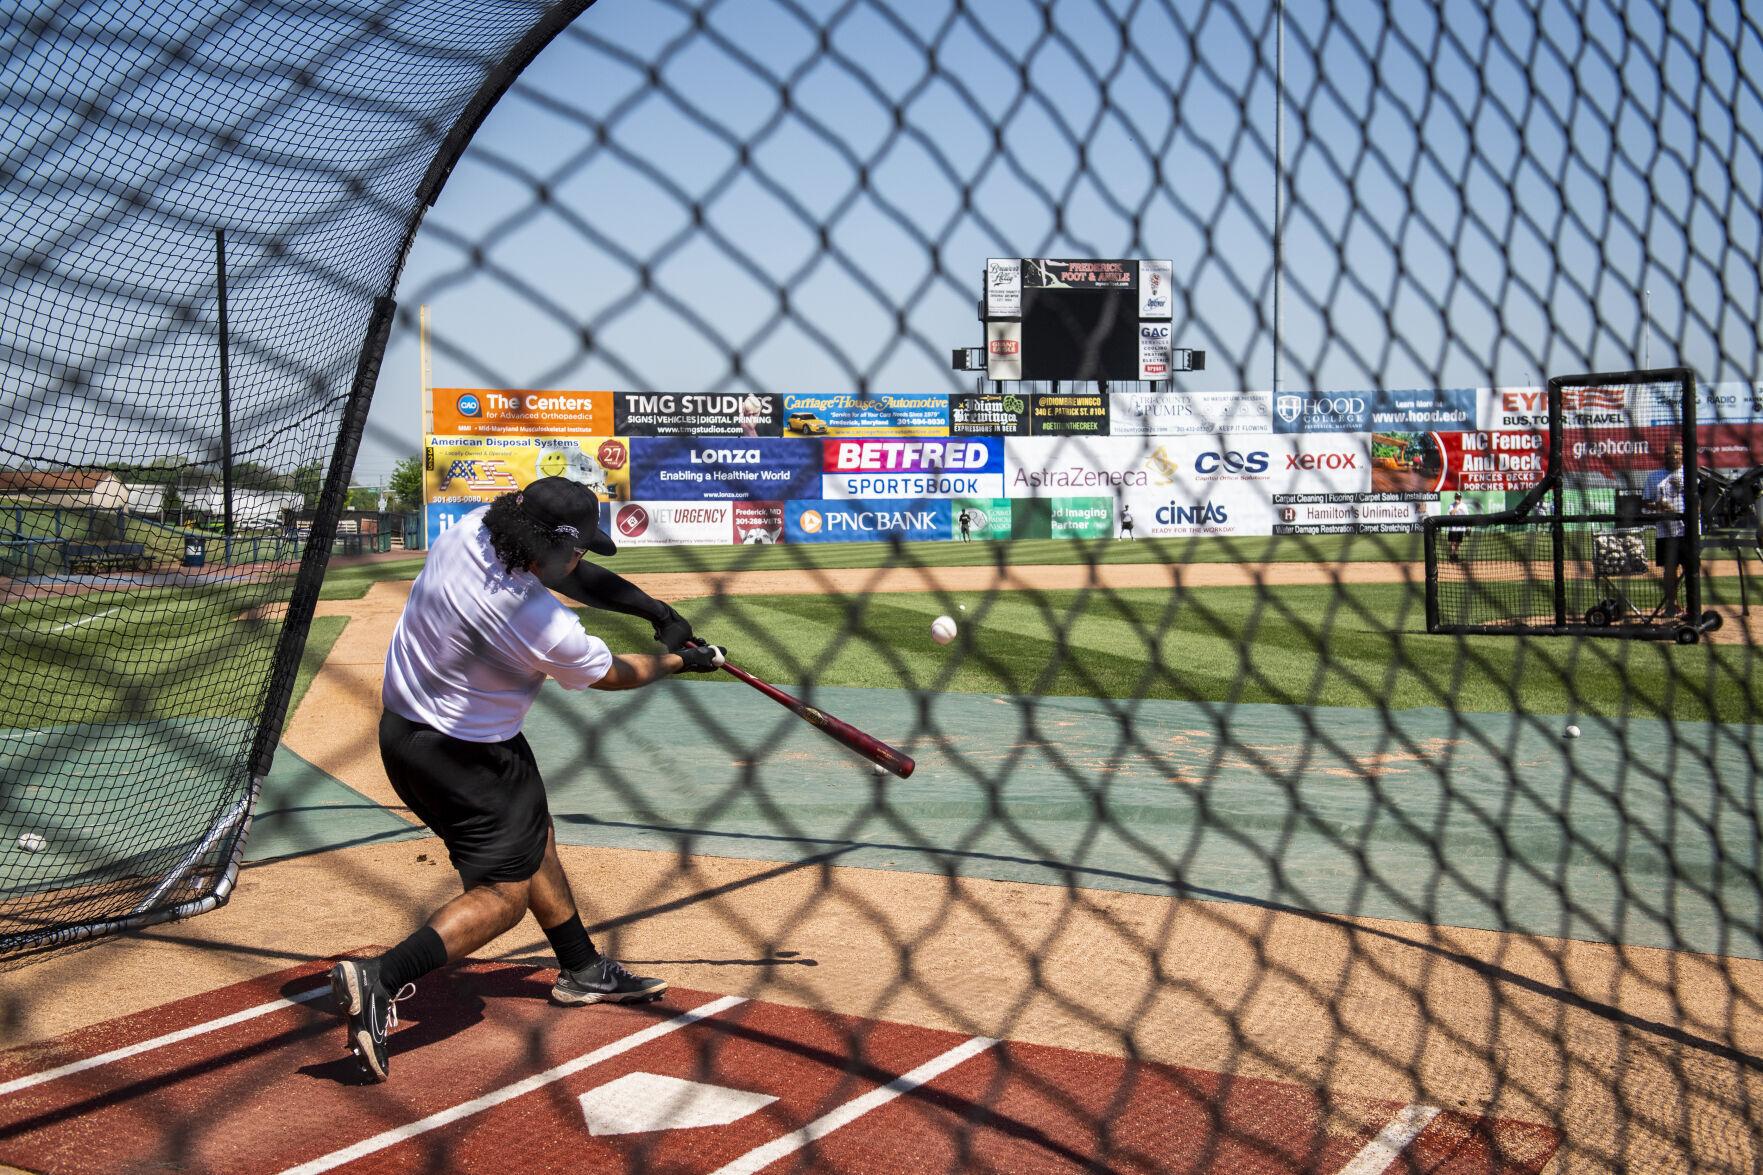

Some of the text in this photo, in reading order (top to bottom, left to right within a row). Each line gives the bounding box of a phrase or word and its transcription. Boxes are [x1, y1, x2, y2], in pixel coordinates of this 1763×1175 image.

[1069, 263, 1123, 272] FREDERICK
[1061, 272, 1130, 281] FOOT & ANKLE
[1141, 327, 1168, 338] GAC
[486, 394, 592, 410] The Centers
[625, 395, 773, 414] TMG STUDIS
[784, 395, 948, 411] Carriage House Automotive
[964, 398, 1003, 412] Idiom
[1039, 397, 1102, 407] @IDIOMBREWINGCO
[1140, 396, 1192, 404] TRI-COUNTY
[1303, 397, 1365, 415] HOOD
[486, 411, 497, 419] for
[541, 412, 592, 421] Orthopaedics
[1035, 408, 1046, 416] 340
[1055, 408, 1079, 416] PATRICK
[1080, 408, 1088, 416] ST.
[1090, 408, 1105, 416] #104
[1144, 404, 1193, 416] PUMPS
[830, 418, 888, 426] Frederick, Maryland
[1303, 415, 1363, 423] COLLEGE
[1371, 410, 1467, 423] www.hood.edu
[478, 425, 518, 433] Mid-Maryland
[657, 426, 743, 435] www.tmgstudios.com
[431, 437, 579, 449] American Disposal Systems
[1462, 432, 1543, 450] MC Fence
[603, 447, 621, 462] 27
[1573, 437, 1648, 460] graphcom
[690, 450, 760, 463] Lonza
[837, 442, 989, 469] BETFRED
[1286, 453, 1356, 470] xerox
[1194, 451, 1269, 474] COS
[1462, 453, 1542, 471] And Deck
[439, 460, 518, 491] ADS
[660, 471, 702, 482] Enabling
[713, 471, 759, 480] Healthier
[760, 471, 790, 480] World
[1013, 467, 1148, 487] AstraZeneca
[1468, 474, 1535, 482] FENCES DECKS
[848, 478, 978, 494] SPORTSBOOK
[1464, 482, 1504, 491] PORCHES
[1274, 492, 1437, 504] Carpet Cleaning Flooring Carpet Sales Installation
[652, 509, 727, 524] VET URGENCY
[1065, 507, 1107, 519] Imaging
[1307, 506, 1359, 520] Hamilton's
[1362, 505, 1409, 519] Unlimited
[1051, 521, 1089, 529] Partner
[1295, 525, 1319, 535] Damage
[1322, 525, 1354, 533] Restoration
[1360, 525, 1380, 534] Carpet
[1381, 523, 1410, 533] Stretching
